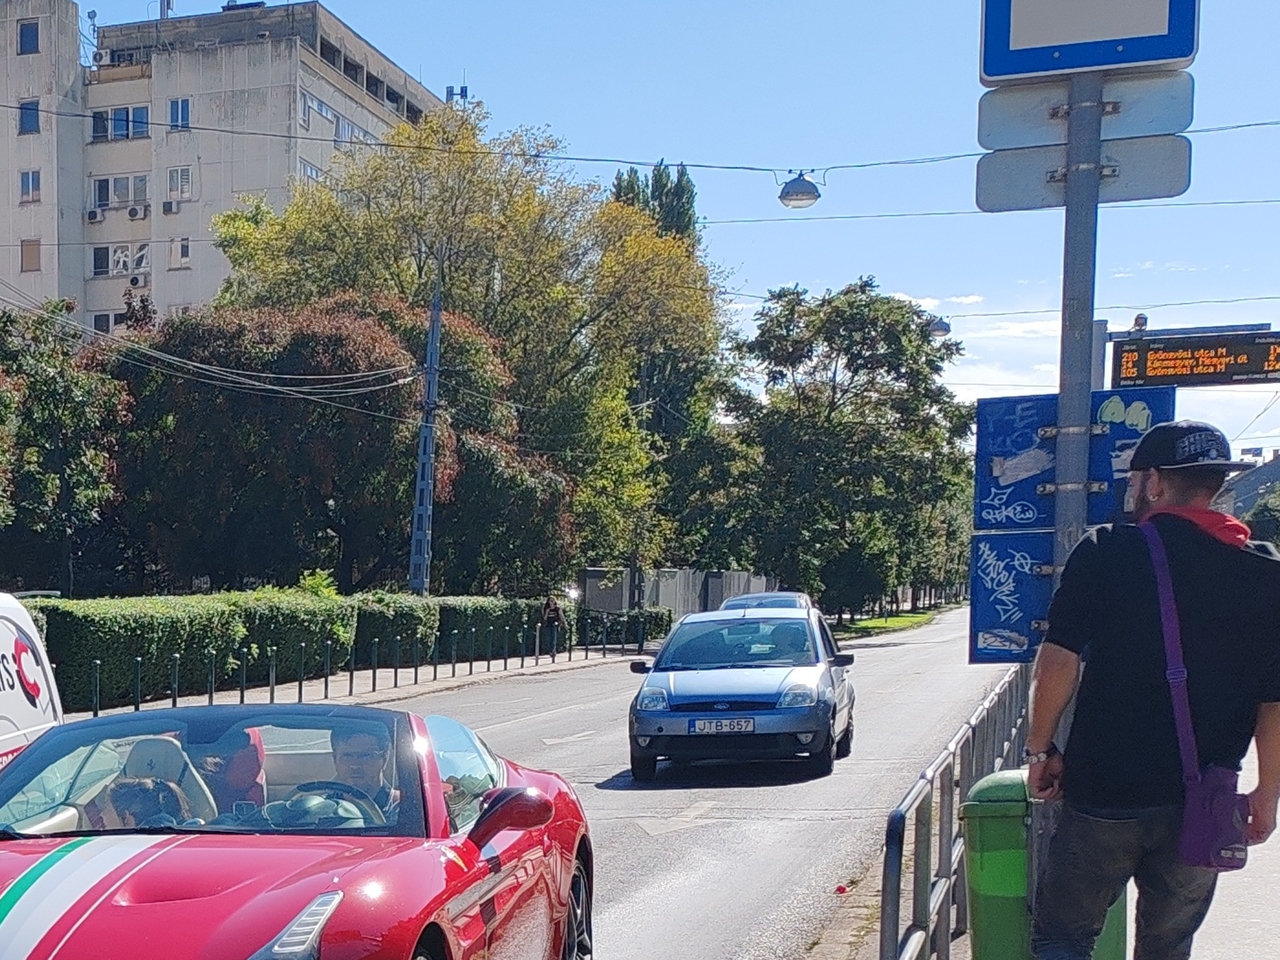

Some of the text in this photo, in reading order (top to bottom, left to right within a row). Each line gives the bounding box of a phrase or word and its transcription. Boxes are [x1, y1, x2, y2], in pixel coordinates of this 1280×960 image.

[1122, 352, 1138, 361] 210
[1194, 348, 1215, 358] utca
[1217, 347, 1227, 356] M
[1120, 368, 1138, 378] 105
[1193, 365, 1215, 374] utca
[1216, 363, 1226, 373] M
[1122, 360, 1133, 369] 14
[697, 720, 751, 732] JTB-657
